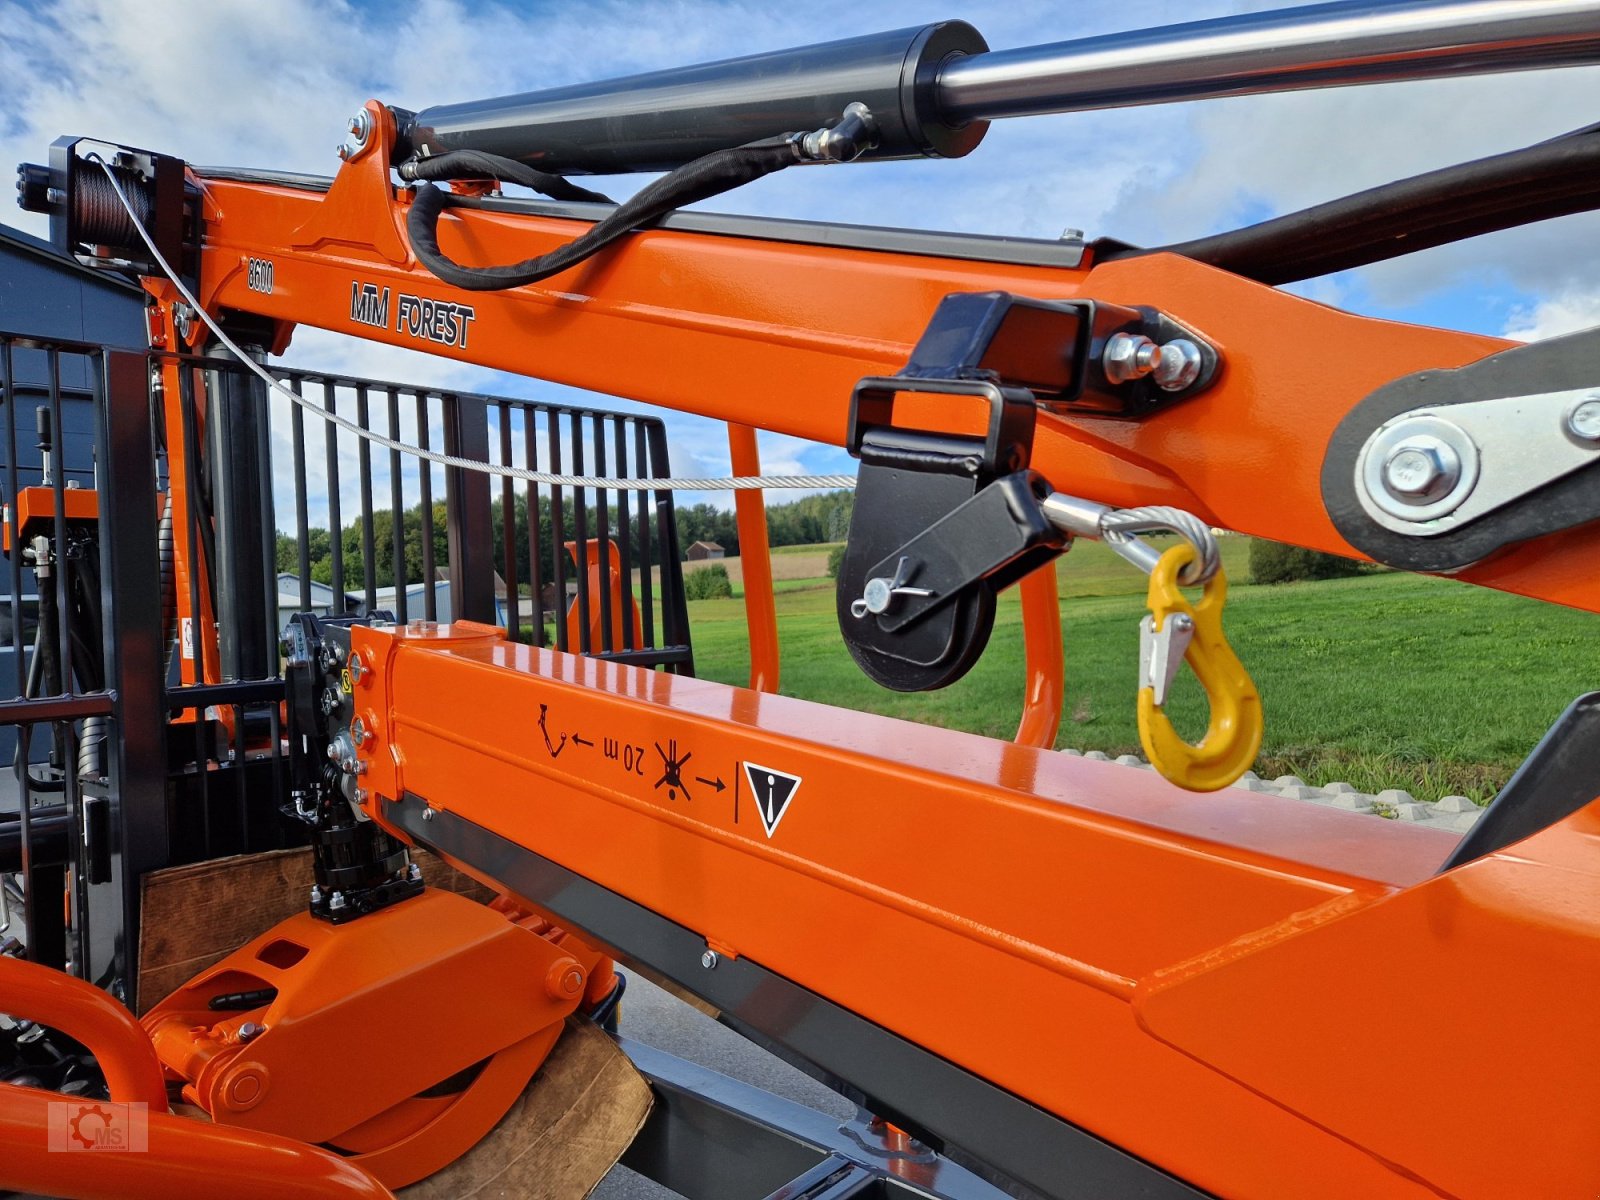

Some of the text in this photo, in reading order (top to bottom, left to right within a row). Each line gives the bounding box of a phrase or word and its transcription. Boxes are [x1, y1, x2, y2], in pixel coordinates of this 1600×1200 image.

[248, 257, 274, 295] 8600
[350, 280, 475, 349] MTM FOREST
[604, 737, 644, 775] 20 m
